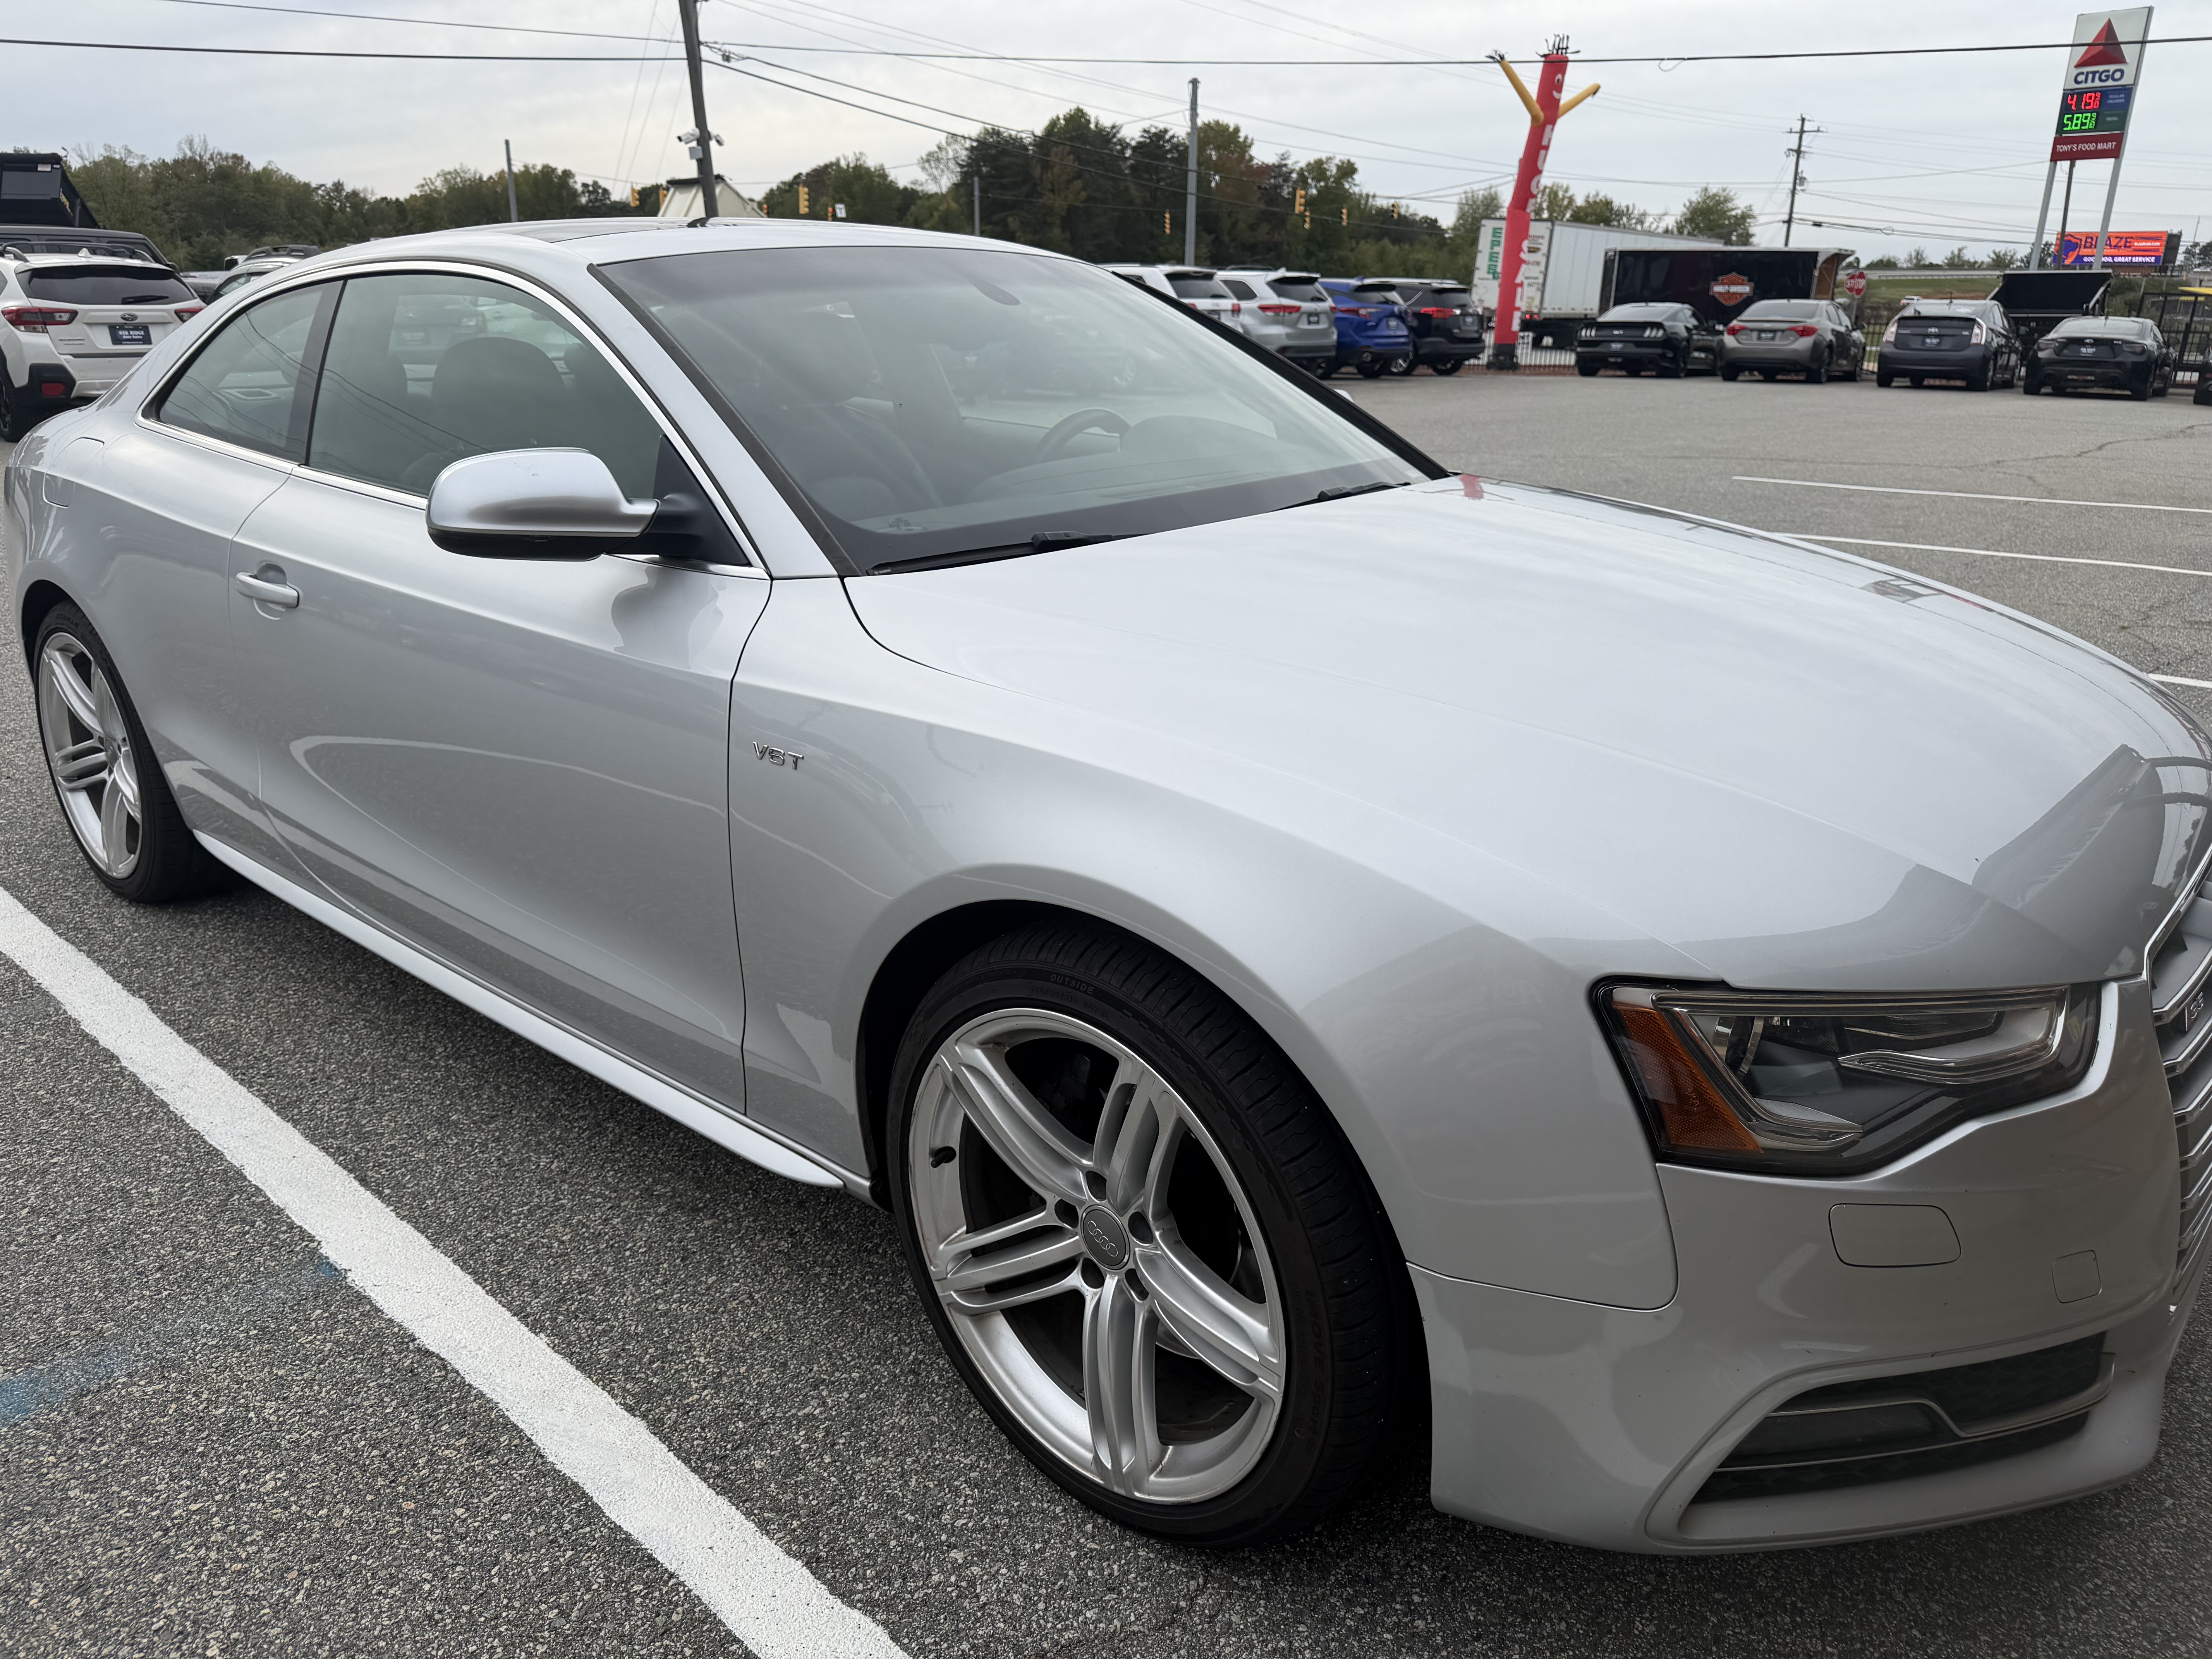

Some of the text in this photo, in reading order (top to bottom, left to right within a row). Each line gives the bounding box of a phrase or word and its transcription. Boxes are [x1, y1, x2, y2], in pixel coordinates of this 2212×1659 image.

[2074, 69, 2125, 84] CITGO
[2056, 144, 2077, 152] TONY'S
[2078, 143, 2096, 151] FOOD
[1854, 278, 1866, 289] STOP
[753, 741, 804, 770] V6T
[1050, 974, 1094, 994] OUTSIDE
[1030, 985, 1077, 1004] 255/35ZR19
[2190, 992, 2203, 1020] S5
